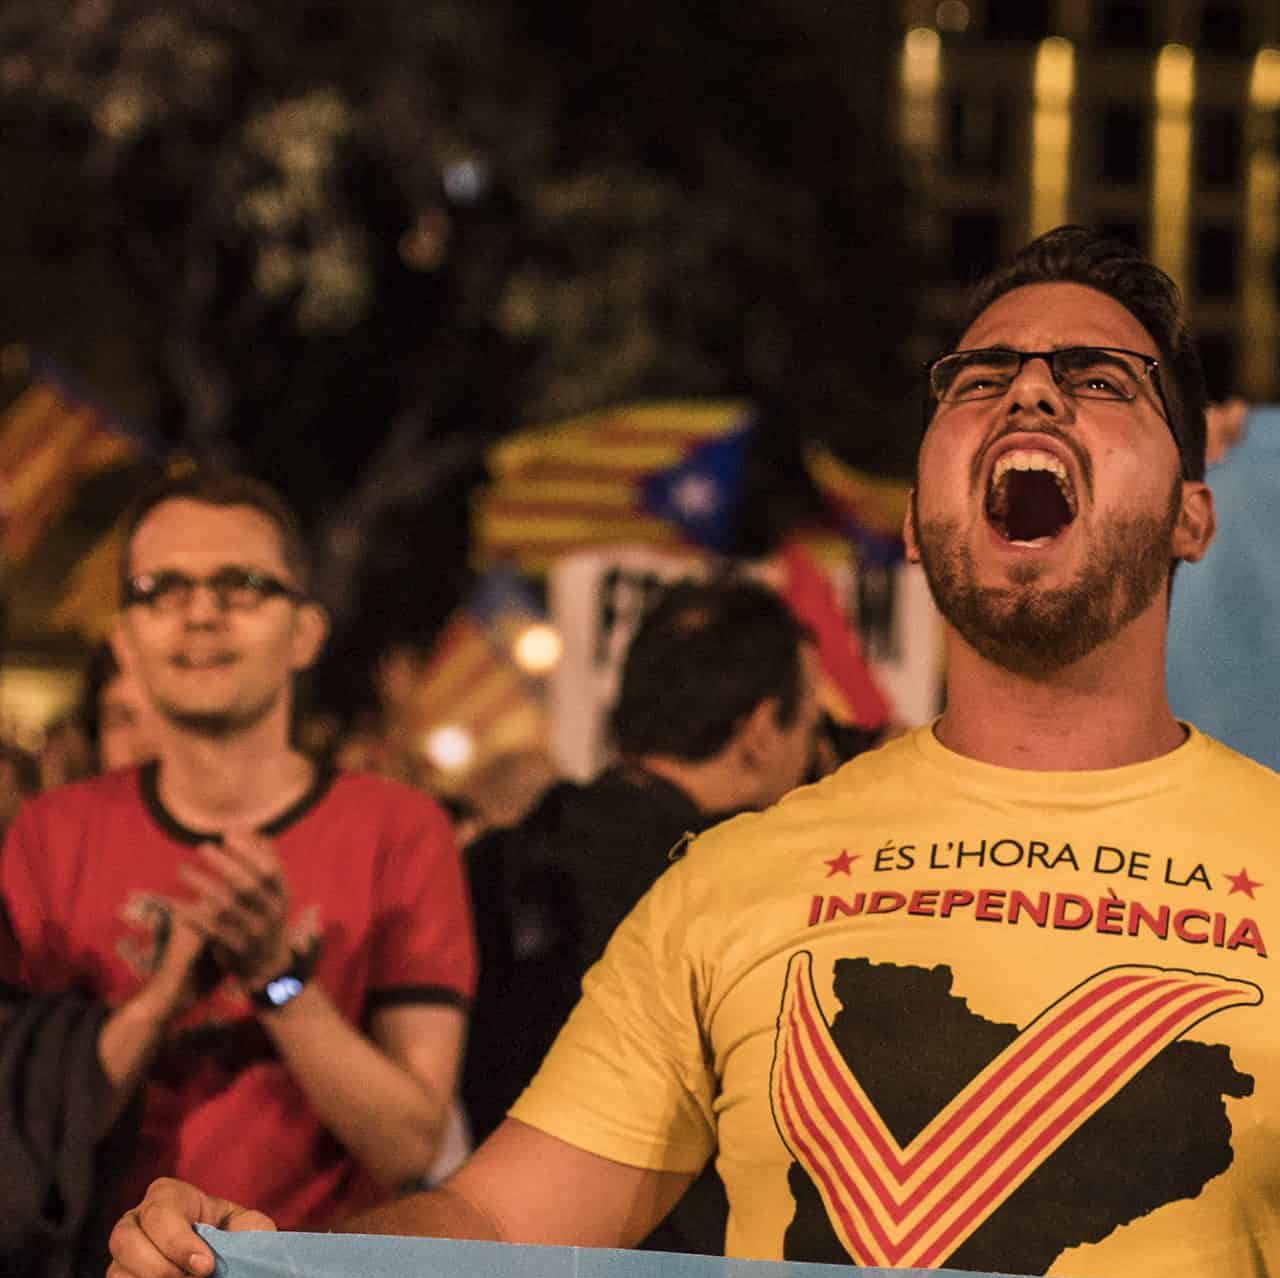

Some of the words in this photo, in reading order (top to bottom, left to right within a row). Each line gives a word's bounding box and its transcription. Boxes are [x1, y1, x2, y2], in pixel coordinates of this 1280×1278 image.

[874, 840, 915, 872] ÉS
[929, 839, 1080, 871] L'HORA
[1093, 846, 1149, 881] DE
[1163, 858, 1213, 890] LA
[807, 887, 1268, 958] INDEPENDÈNCIA
